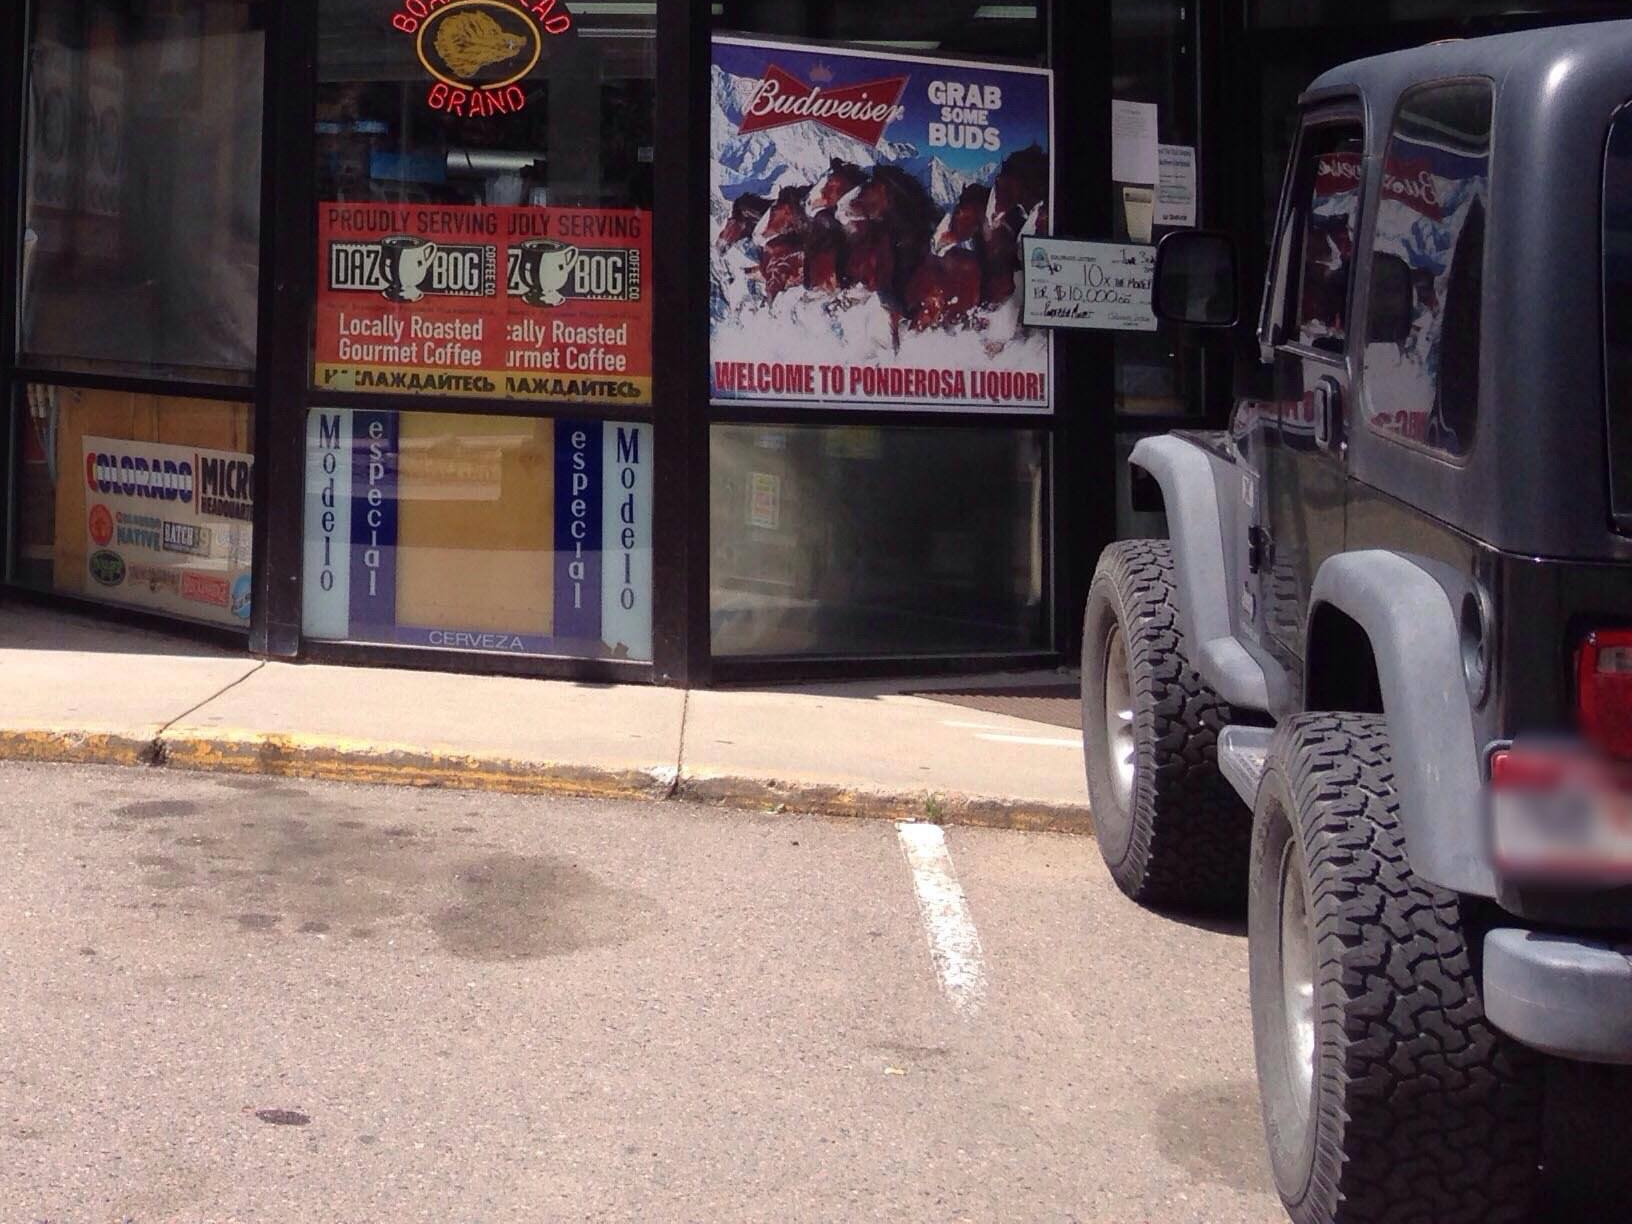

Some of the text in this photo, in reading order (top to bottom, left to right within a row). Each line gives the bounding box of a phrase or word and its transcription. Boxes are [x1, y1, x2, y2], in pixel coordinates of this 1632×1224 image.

[427, 82, 526, 118] BRAND
[745, 76, 905, 122] Budweiser
[927, 79, 1002, 110] GRAB
[939, 107, 989, 126] SOME
[928, 124, 1001, 152] BUDS
[328, 209, 497, 236] PROUDLY SERVING
[558, 213, 642, 239] SERVING
[574, 255, 624, 295] BOG
[339, 312, 483, 341] Locally Roasted
[507, 318, 627, 346] ally Roasted
[339, 338, 482, 367] Gourmet Coffee
[566, 347, 627, 373] Coffee
[714, 360, 1046, 403] WELCOME TO PONDEROSA LIQUOR!
[86, 452, 193, 503] COLORADO
[319, 413, 341, 592] Modelo
[364, 421, 384, 596] especial
[567, 430, 589, 609] especial
[617, 427, 640, 611] Modelo
[428, 630, 524, 651] CERVEZA
